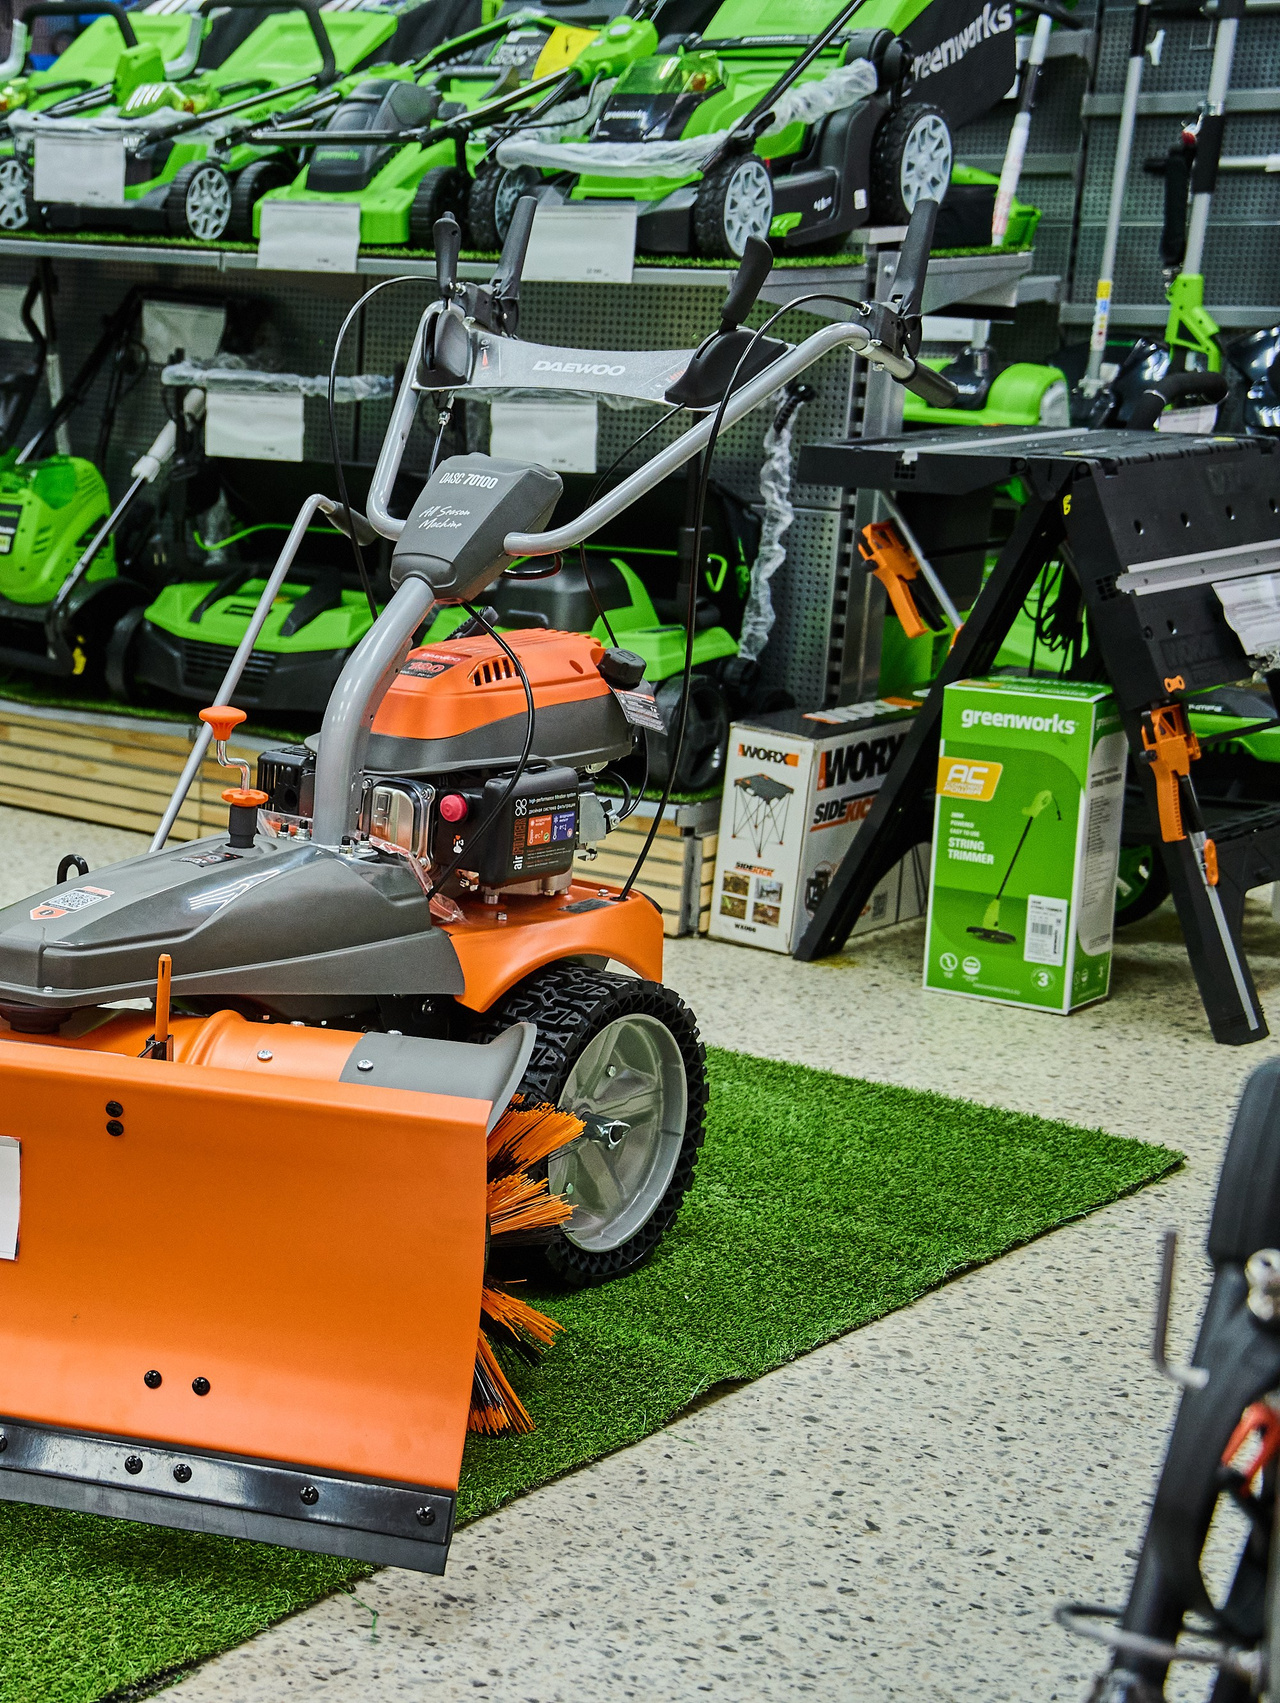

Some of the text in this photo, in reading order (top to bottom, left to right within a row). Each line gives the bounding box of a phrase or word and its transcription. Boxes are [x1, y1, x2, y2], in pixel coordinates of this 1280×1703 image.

[910, 2, 1013, 81] reenworks
[532, 360, 626, 377] DAEWOO
[439, 472, 499, 489] DASC 70100
[437, 505, 470, 517] Season
[418, 517, 462, 530] Machine
[961, 708, 1075, 735] greenworks
[741, 744, 789, 765] WORX
[947, 764, 989, 785] AC
[813, 795, 877, 825] SIDEKIC
[947, 836, 985, 852] STRING
[947, 848, 994, 865] TRIMMER
[735, 861, 774, 878] SIDEKICK
